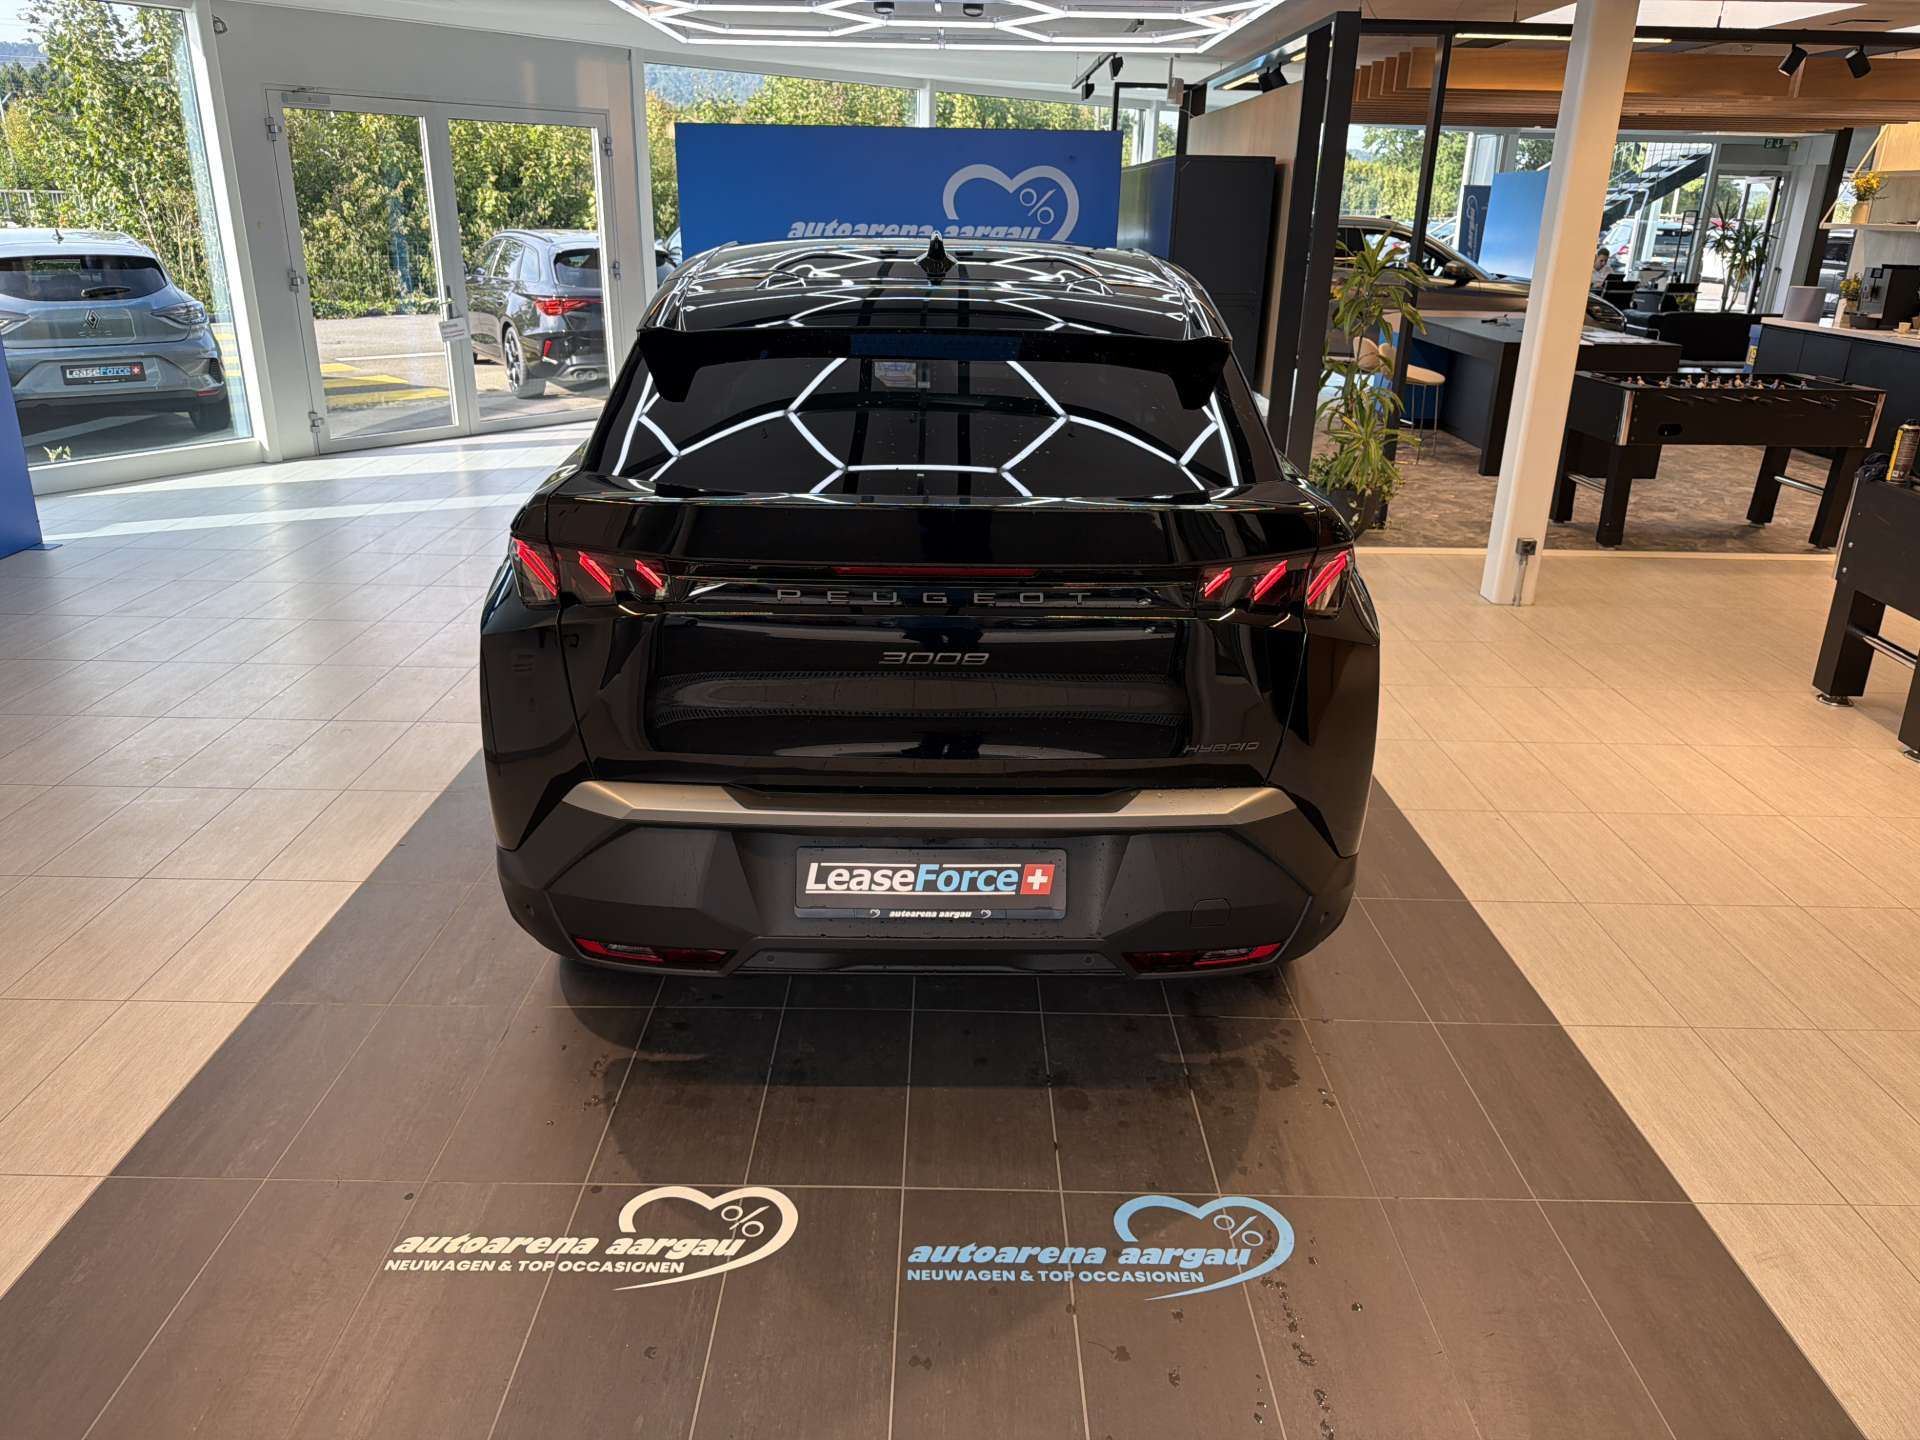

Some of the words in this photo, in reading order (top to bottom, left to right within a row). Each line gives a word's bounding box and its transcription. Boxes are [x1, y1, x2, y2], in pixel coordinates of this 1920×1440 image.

[66, 366, 131, 379] LeaseForce
[776, 589, 1091, 605] PEUGEOT
[879, 651, 990, 665] 3008
[1183, 742, 1260, 753] HYBRID
[805, 862, 1019, 892] LeaseForce
[889, 910, 937, 918] autoarena
[939, 911, 972, 919] aargau
[393, 1233, 599, 1255] autoarena
[605, 1236, 746, 1260] aargau
[907, 1242, 1107, 1264] autoarena
[1117, 1247, 1252, 1269] aargau
[384, 1260, 497, 1272] NEUWAGEN
[498, 1260, 512, 1272] &
[518, 1261, 557, 1272] TOP
[559, 1261, 684, 1273] OCCASIONEN
[907, 1269, 1016, 1281] NEUWAGEN
[1020, 1270, 1034, 1281] &
[1037, 1270, 1075, 1282] TOP
[1077, 1271, 1204, 1283] OCCASIONEN
